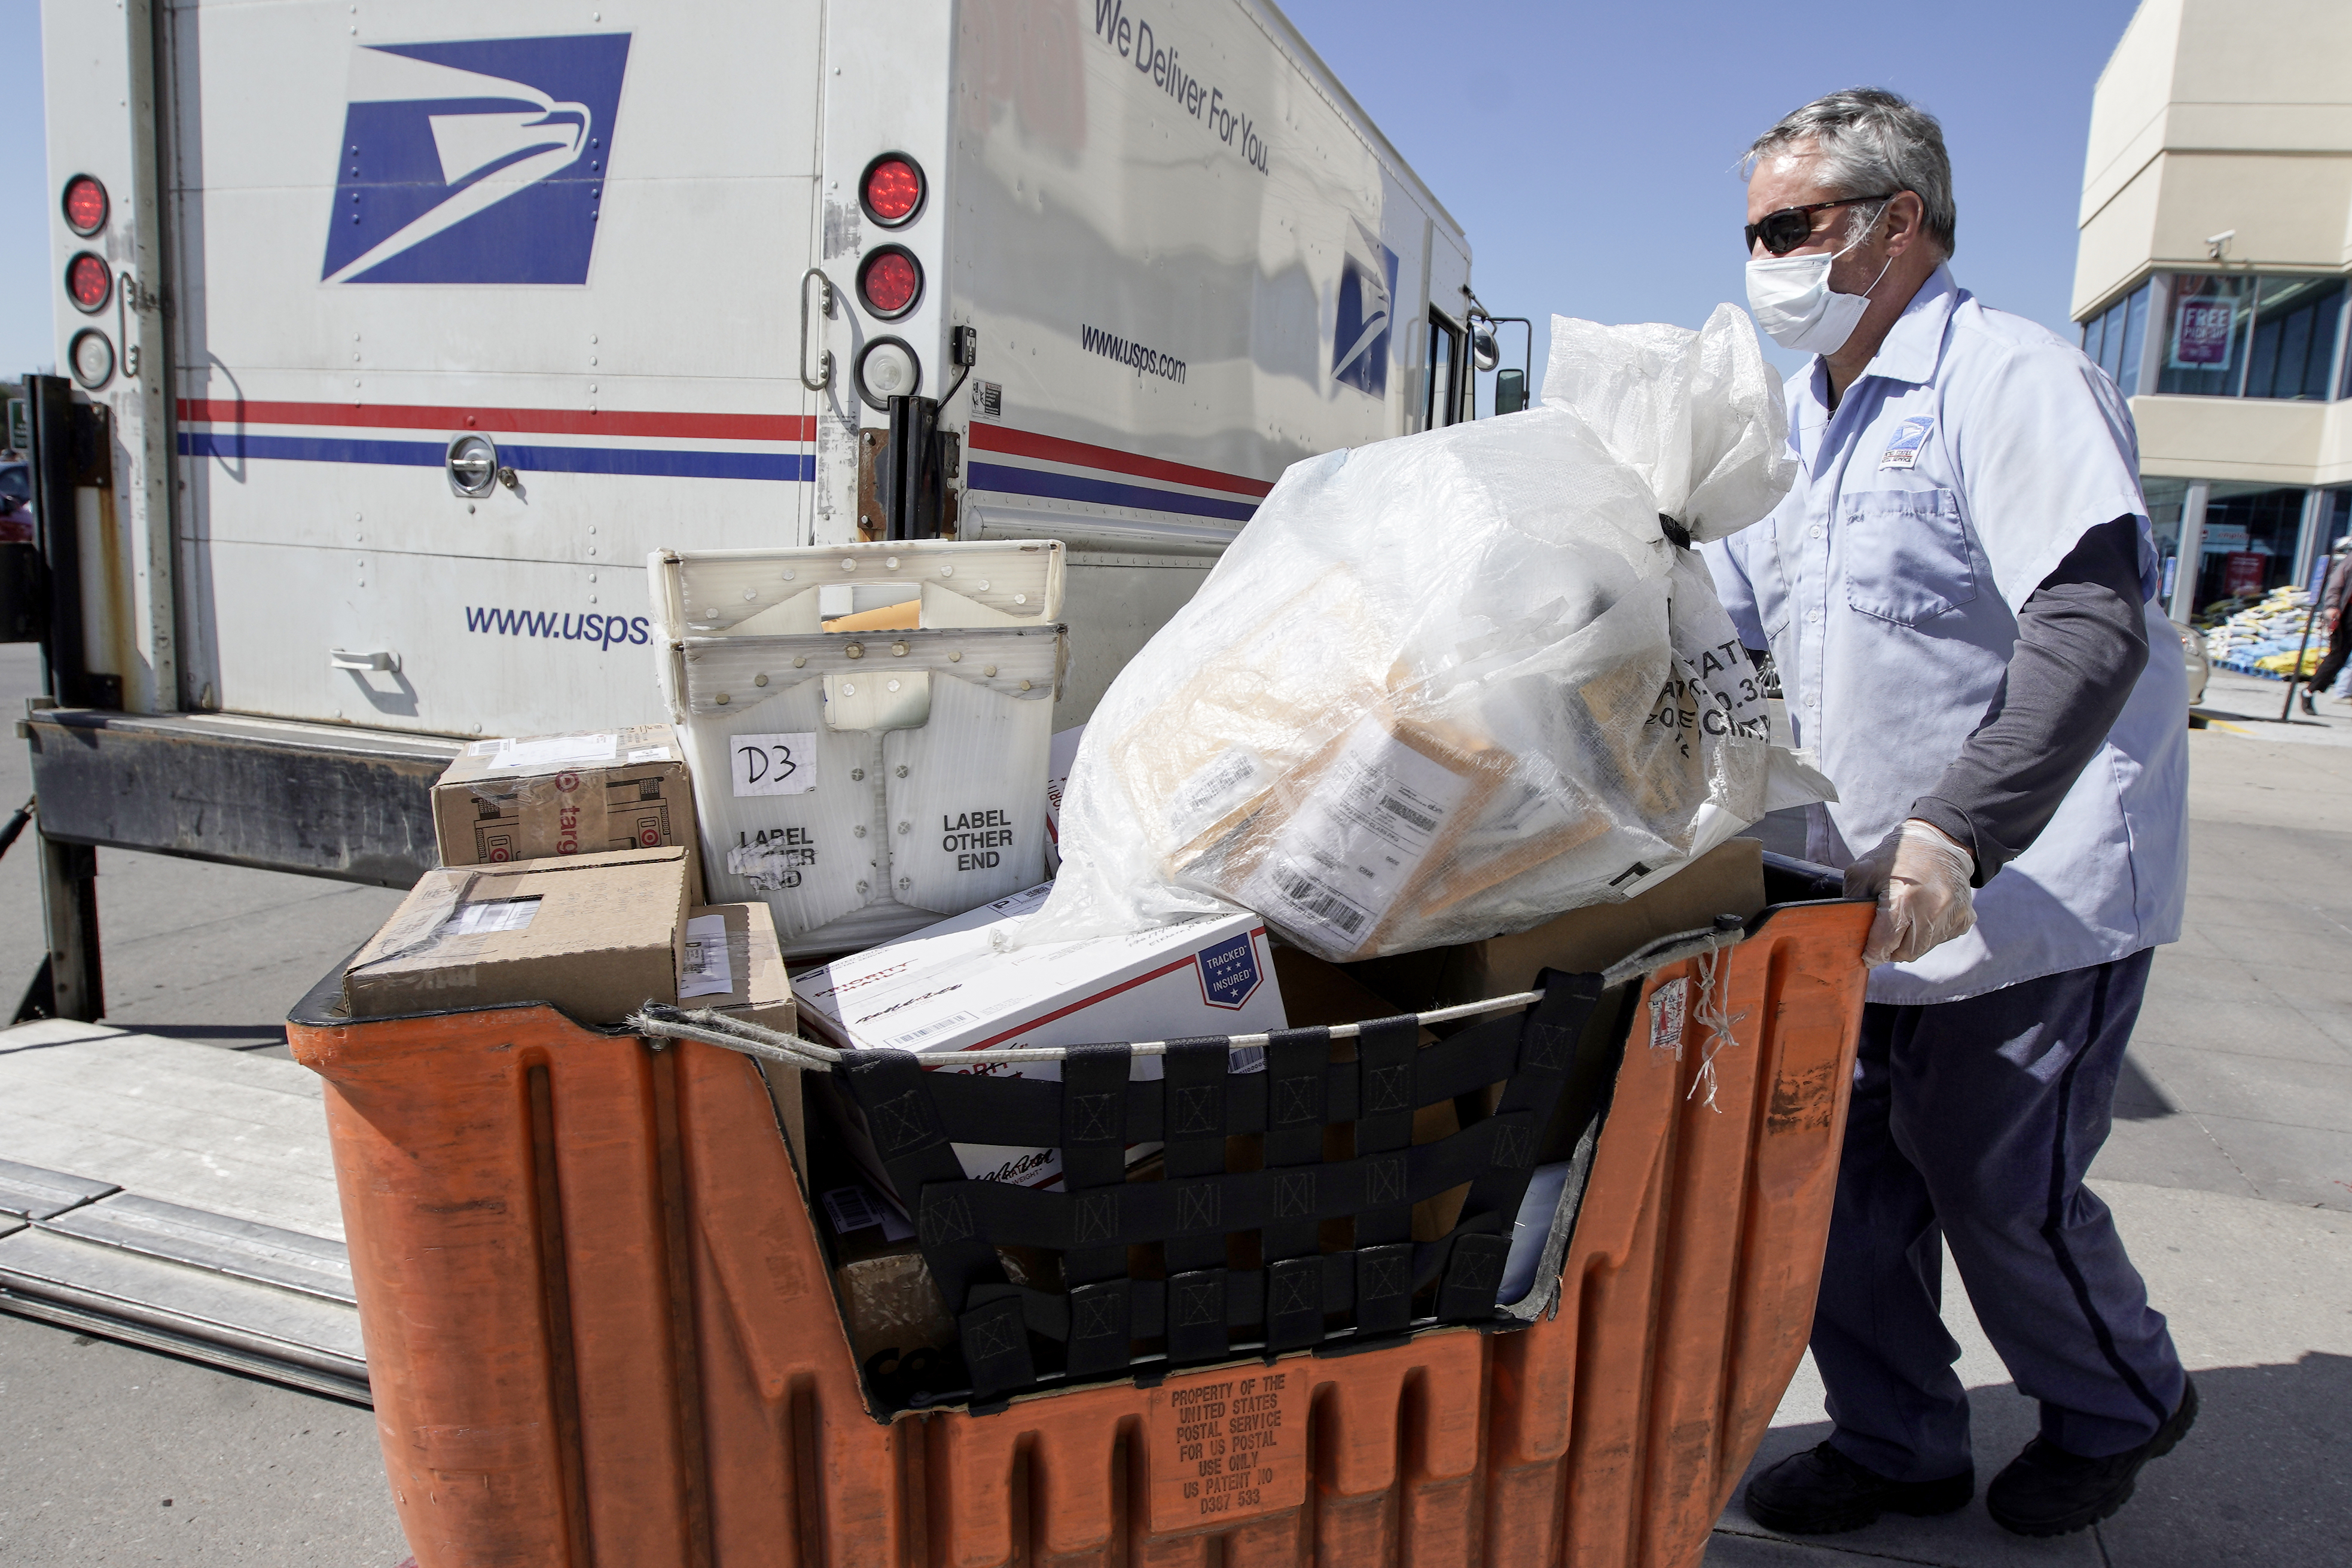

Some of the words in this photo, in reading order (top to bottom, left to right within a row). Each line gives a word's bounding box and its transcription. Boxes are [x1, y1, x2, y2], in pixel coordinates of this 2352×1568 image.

[1096, 0, 1131, 57] We
[1136, 19, 1207, 120] Deliver
[1209, 86, 1238, 146] For
[1241, 112, 1269, 176] You.
[2186, 308, 2229, 327] FREE
[1082, 323, 1186, 385] www.usps.com
[465, 606, 653, 651] www.usps
[737, 745, 797, 784] D3
[944, 809, 1012, 831] LABEL
[942, 829, 1013, 852] OTHER
[957, 851, 1000, 871] END
[1172, 1382, 1233, 1407] PROPERTY
[1241, 1378, 1256, 1395] OF
[1263, 1374, 1285, 1392] THE
[1180, 1402, 1226, 1423] UNITED
[1233, 1393, 1277, 1415] STATES
[1177, 1421, 1222, 1444] POSTAL
[1230, 1410, 1282, 1434] SERVICE
[1180, 1443, 1203, 1462] FOR
[1210, 1439, 1225, 1456] US
[1233, 1430, 1277, 1452] POSTAL
[1199, 1458, 1222, 1477] USE
[1229, 1451, 1258, 1471] ONLY
[1183, 1481, 1199, 1499] US
[1206, 1472, 1250, 1494] PATENT
[1258, 1468, 1273, 1485] NO
[1201, 1494, 1231, 1514] D387
[1238, 1488, 1260, 1507] 533
